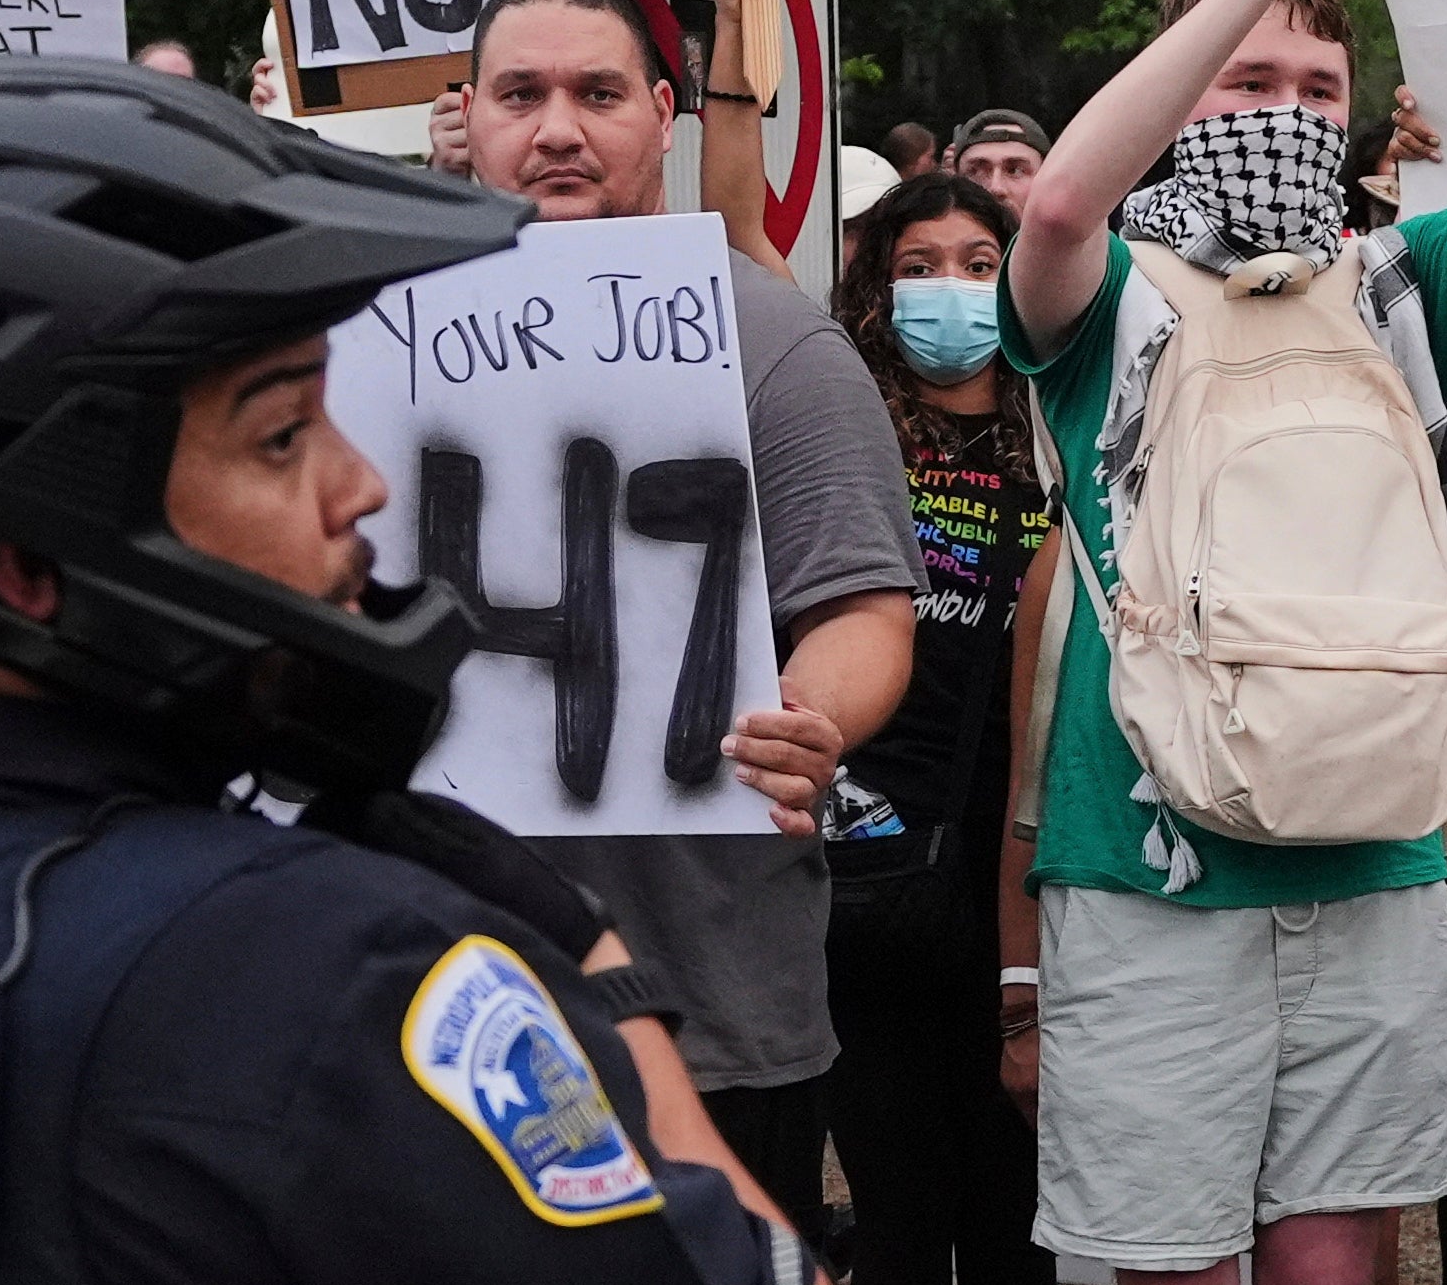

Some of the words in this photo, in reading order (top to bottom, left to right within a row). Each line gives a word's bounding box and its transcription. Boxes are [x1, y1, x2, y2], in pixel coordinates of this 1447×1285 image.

[374, 288, 563, 405] YOUR
[587, 274, 731, 369] JOB!
[419, 437, 749, 802] 47
